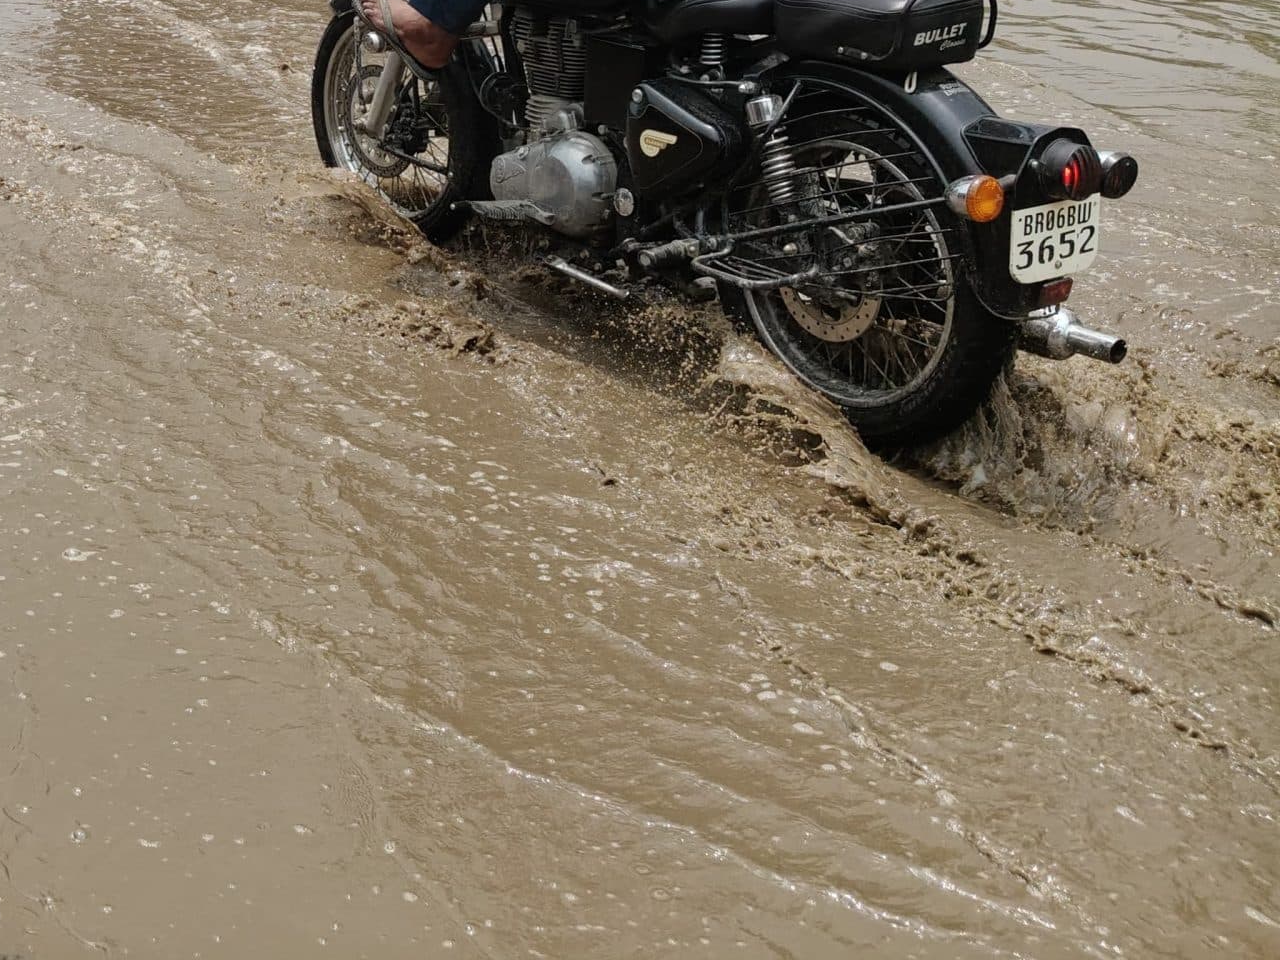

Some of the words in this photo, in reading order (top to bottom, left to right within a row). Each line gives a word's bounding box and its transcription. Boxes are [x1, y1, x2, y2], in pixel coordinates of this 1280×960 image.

[913, 22, 968, 46] BULLET
[1023, 201, 1092, 236] BR06BW
[1016, 225, 1095, 270] 3652
